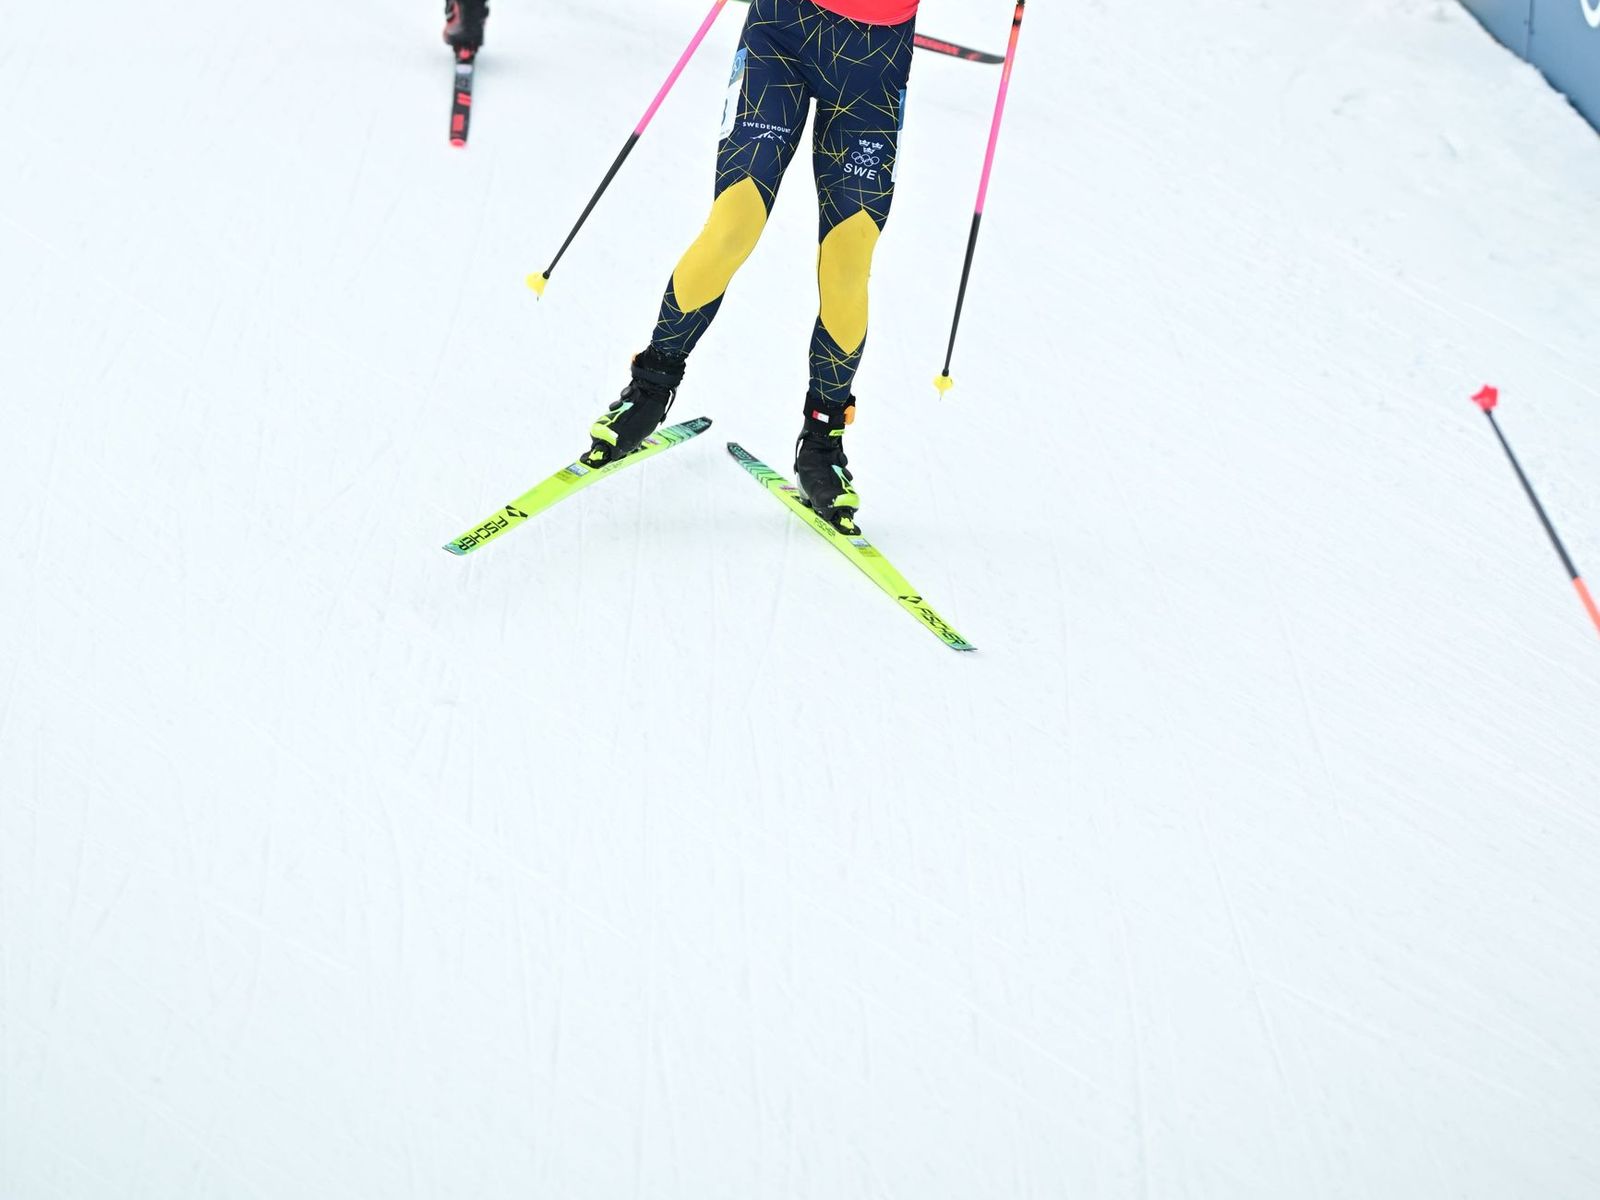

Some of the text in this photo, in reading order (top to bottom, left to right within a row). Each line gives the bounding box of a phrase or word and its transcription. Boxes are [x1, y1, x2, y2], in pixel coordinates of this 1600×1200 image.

[742, 121, 791, 134] SWEDEMOUNT
[843, 162, 878, 181] SWE
[459, 515, 509, 551] FISCHER
[913, 605, 966, 645] FISCHER
